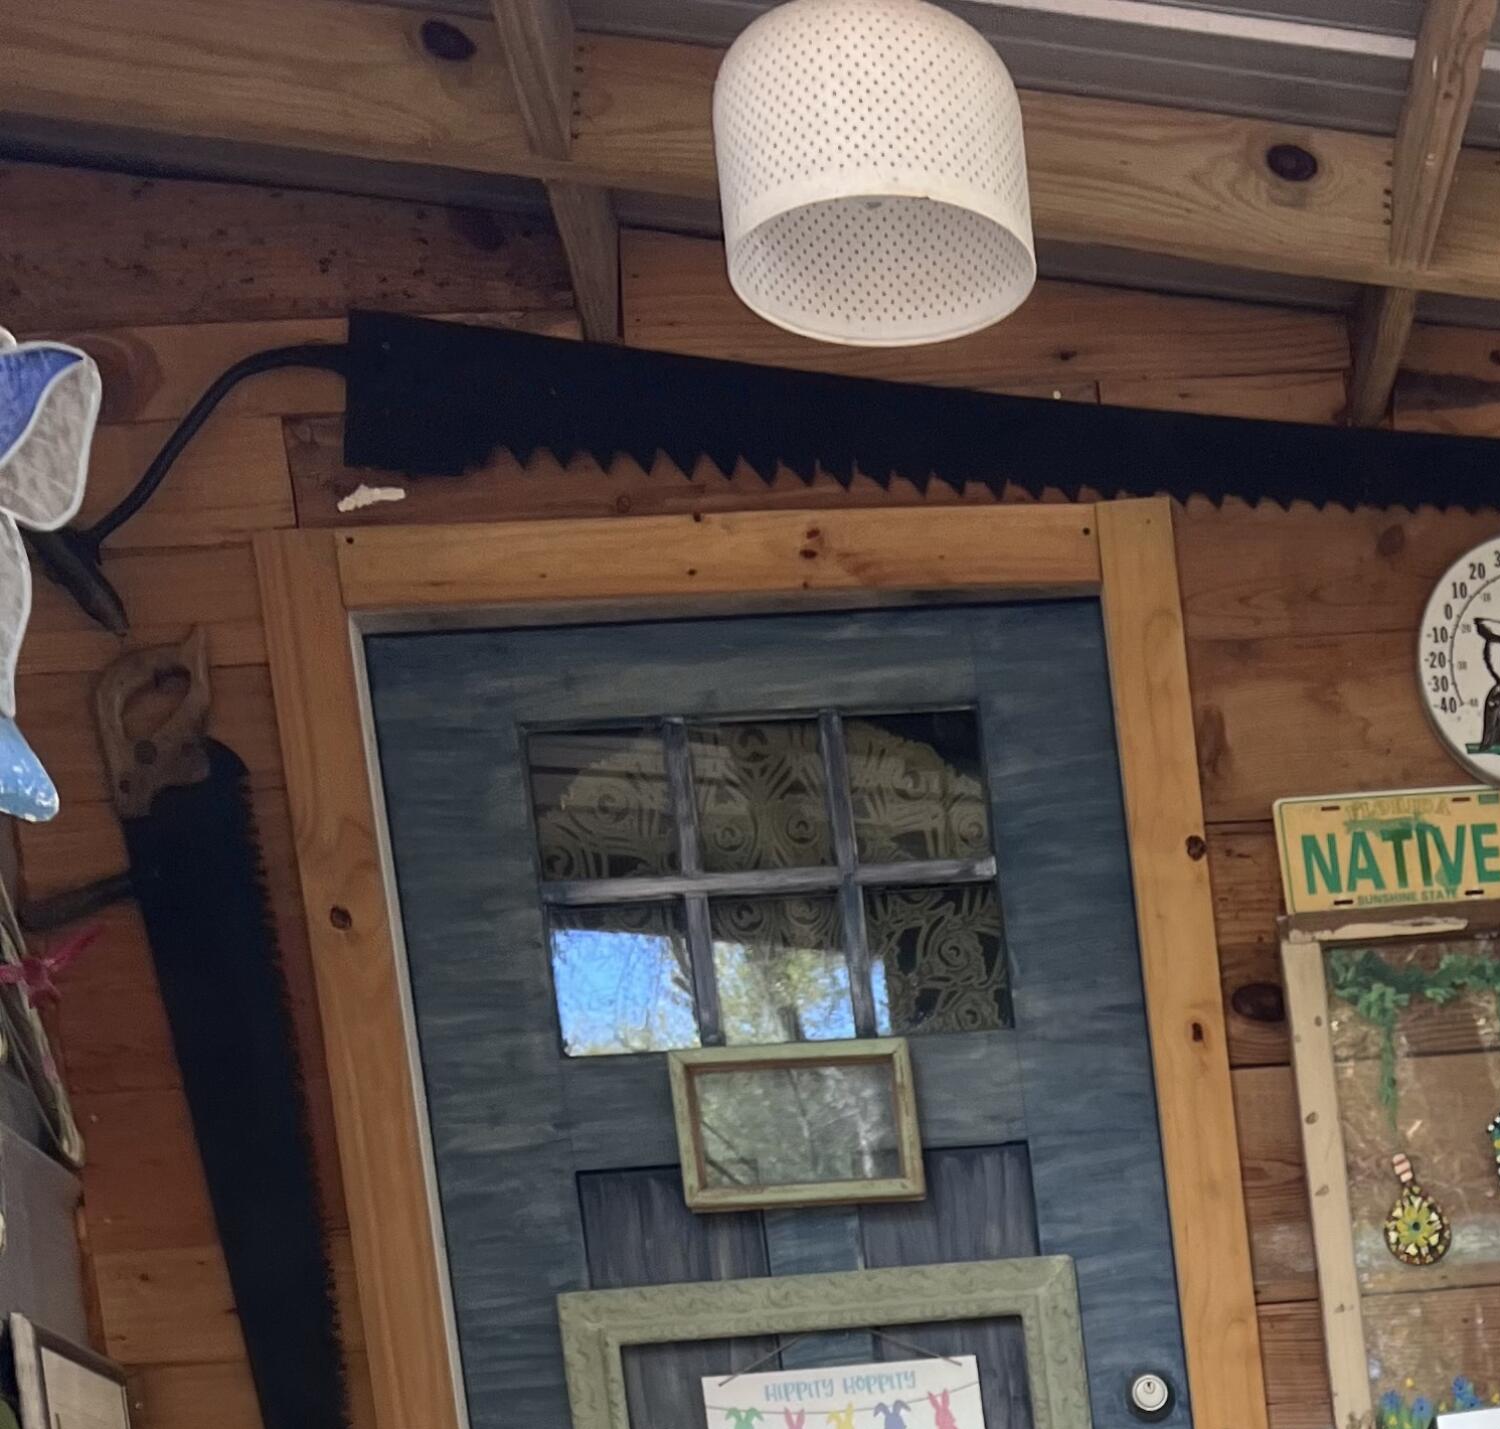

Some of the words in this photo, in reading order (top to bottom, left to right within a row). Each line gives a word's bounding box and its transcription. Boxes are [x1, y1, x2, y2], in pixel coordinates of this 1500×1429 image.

[1469, 562, 1486, 580] 20
[1452, 582, 1467, 599] 10
[1444, 603, 1453, 620] 0
[1424, 651, 1446, 668] -20
[1357, 891, 1417, 906] SUNSHINE
[764, 1378, 834, 1401] HIPPITY
[842, 1370, 916, 1395] HOPPITY
